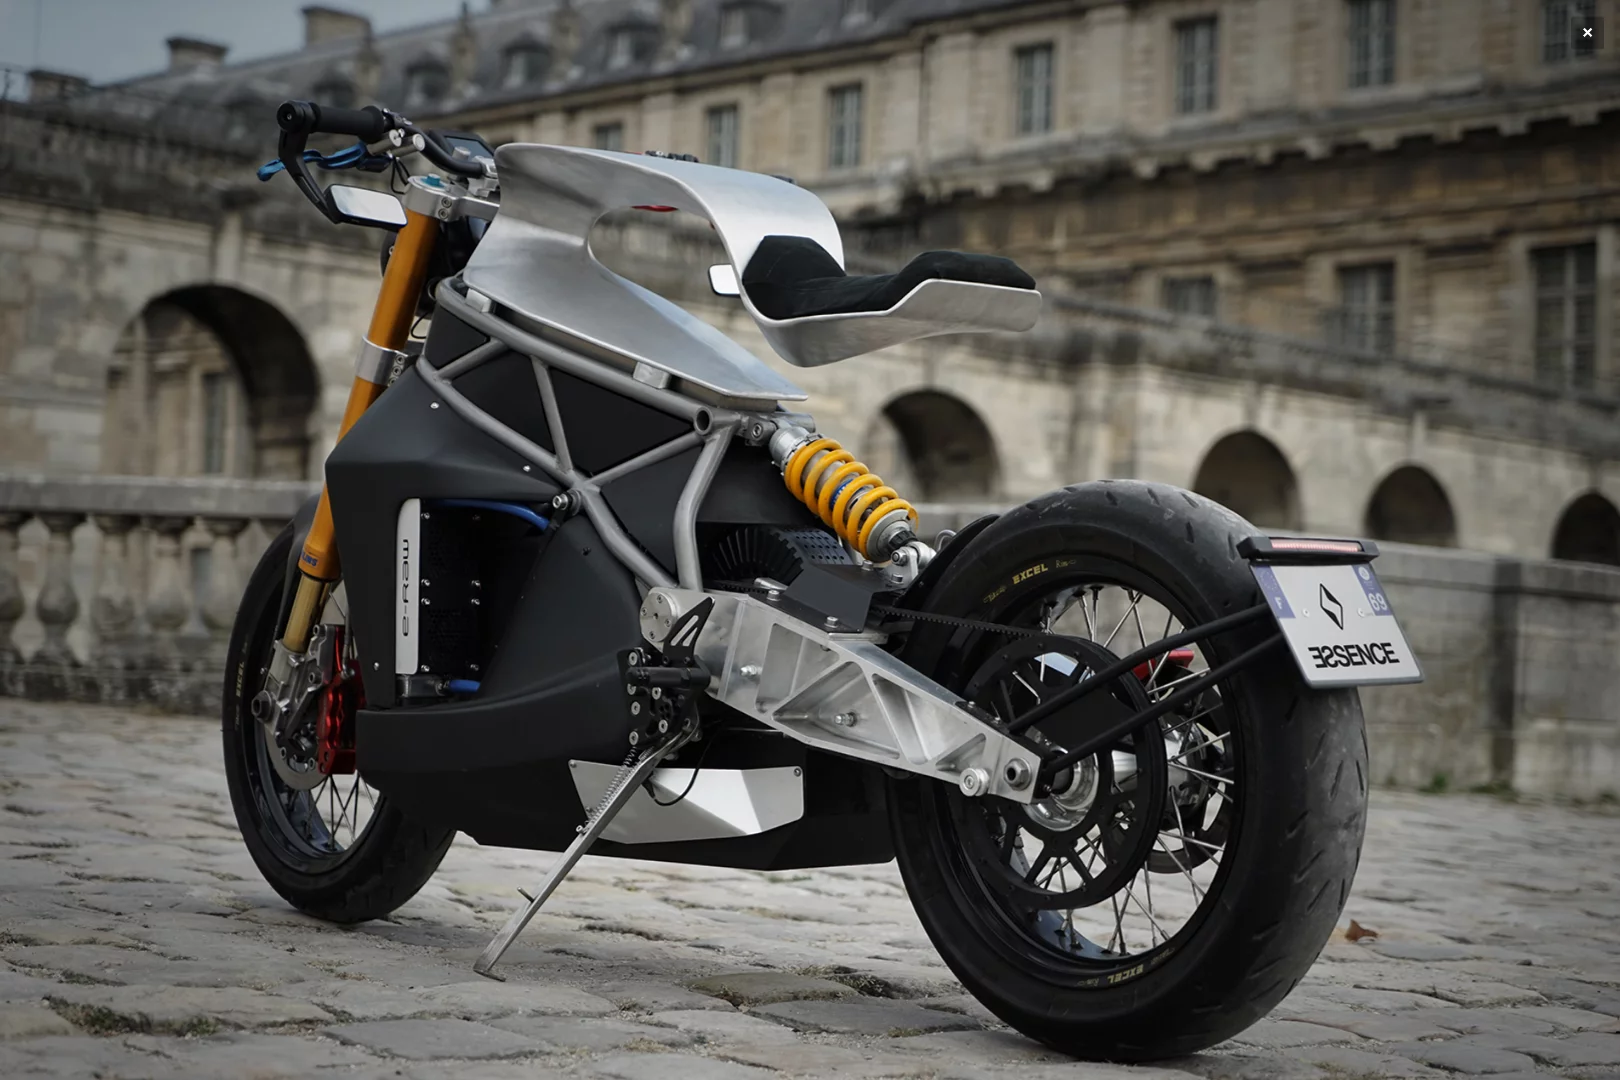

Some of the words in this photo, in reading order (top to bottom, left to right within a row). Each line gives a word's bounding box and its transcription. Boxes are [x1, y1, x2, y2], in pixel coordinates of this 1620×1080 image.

[1012, 563, 1048, 584] EXCEL
[1274, 597, 1283, 610] F
[1368, 592, 1388, 611] 69
[1308, 642, 1400, 668] ESSENCE
[235, 661, 245, 697] EXCEL
[1107, 964, 1144, 984] EXCEL
